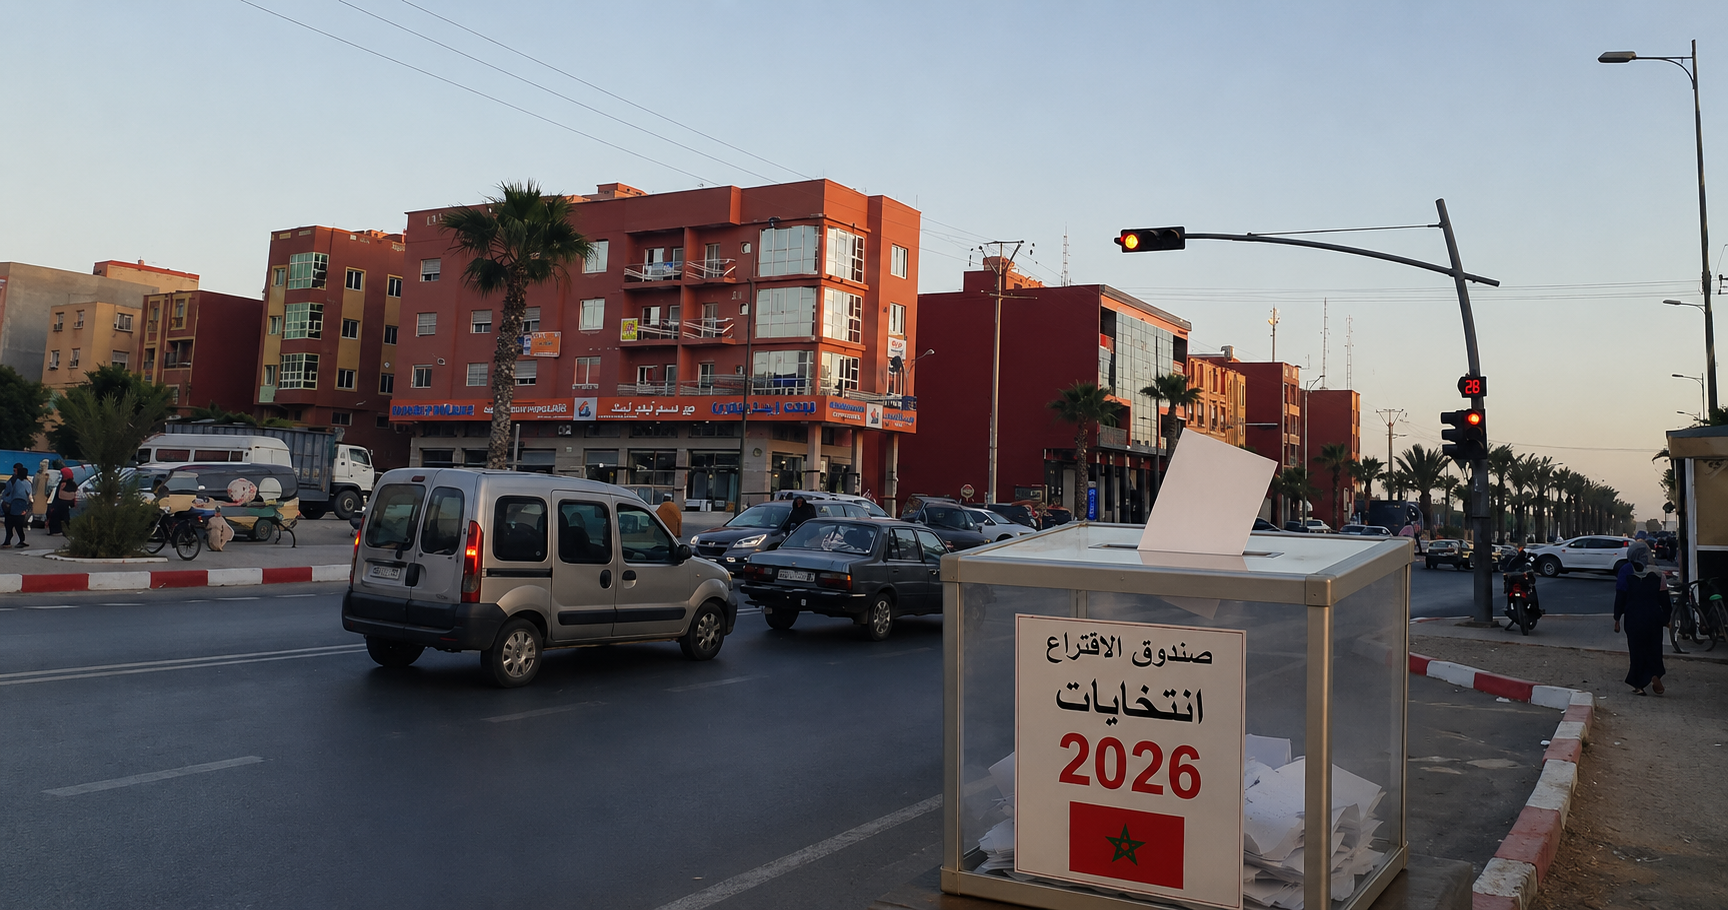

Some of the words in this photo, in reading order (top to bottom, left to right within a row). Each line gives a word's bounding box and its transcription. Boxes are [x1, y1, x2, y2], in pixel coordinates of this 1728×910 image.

[1465, 379, 1480, 394] 28
[1046, 632, 1122, 663] الاقتراع
[1131, 640, 1213, 667] صندوق
[1058, 732, 1202, 800] 2026
